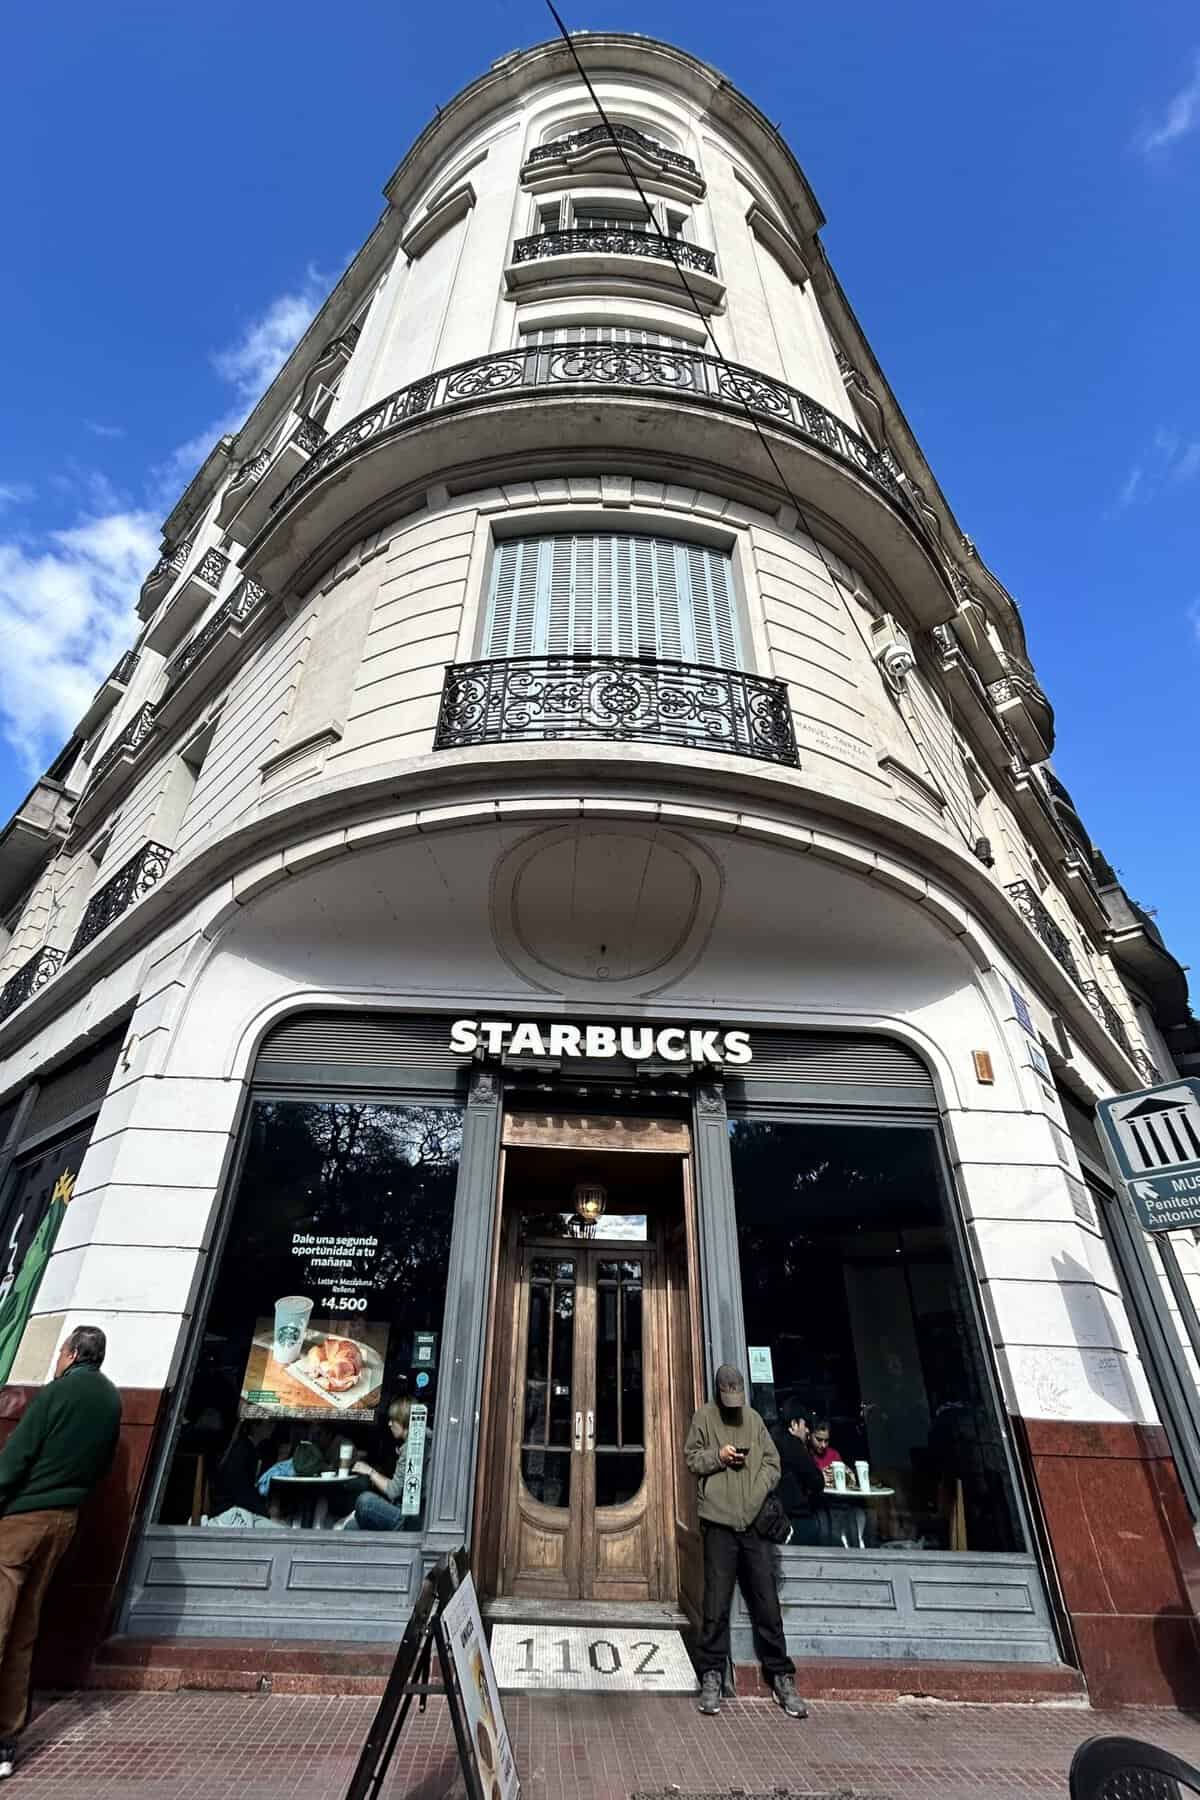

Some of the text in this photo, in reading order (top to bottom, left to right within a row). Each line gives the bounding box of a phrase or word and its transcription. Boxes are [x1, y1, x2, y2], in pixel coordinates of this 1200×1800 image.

[449, 1020, 753, 1064] STARBUCKS
[1145, 1196, 1200, 1211] Peniten
[292, 1233, 378, 1247] Dale una segunda
[291, 1245, 375, 1256] oportunidad a tu
[311, 1256, 353, 1267] mañana
[321, 1297, 367, 1311] $4.500
[515, 1638, 665, 1674] 1102
